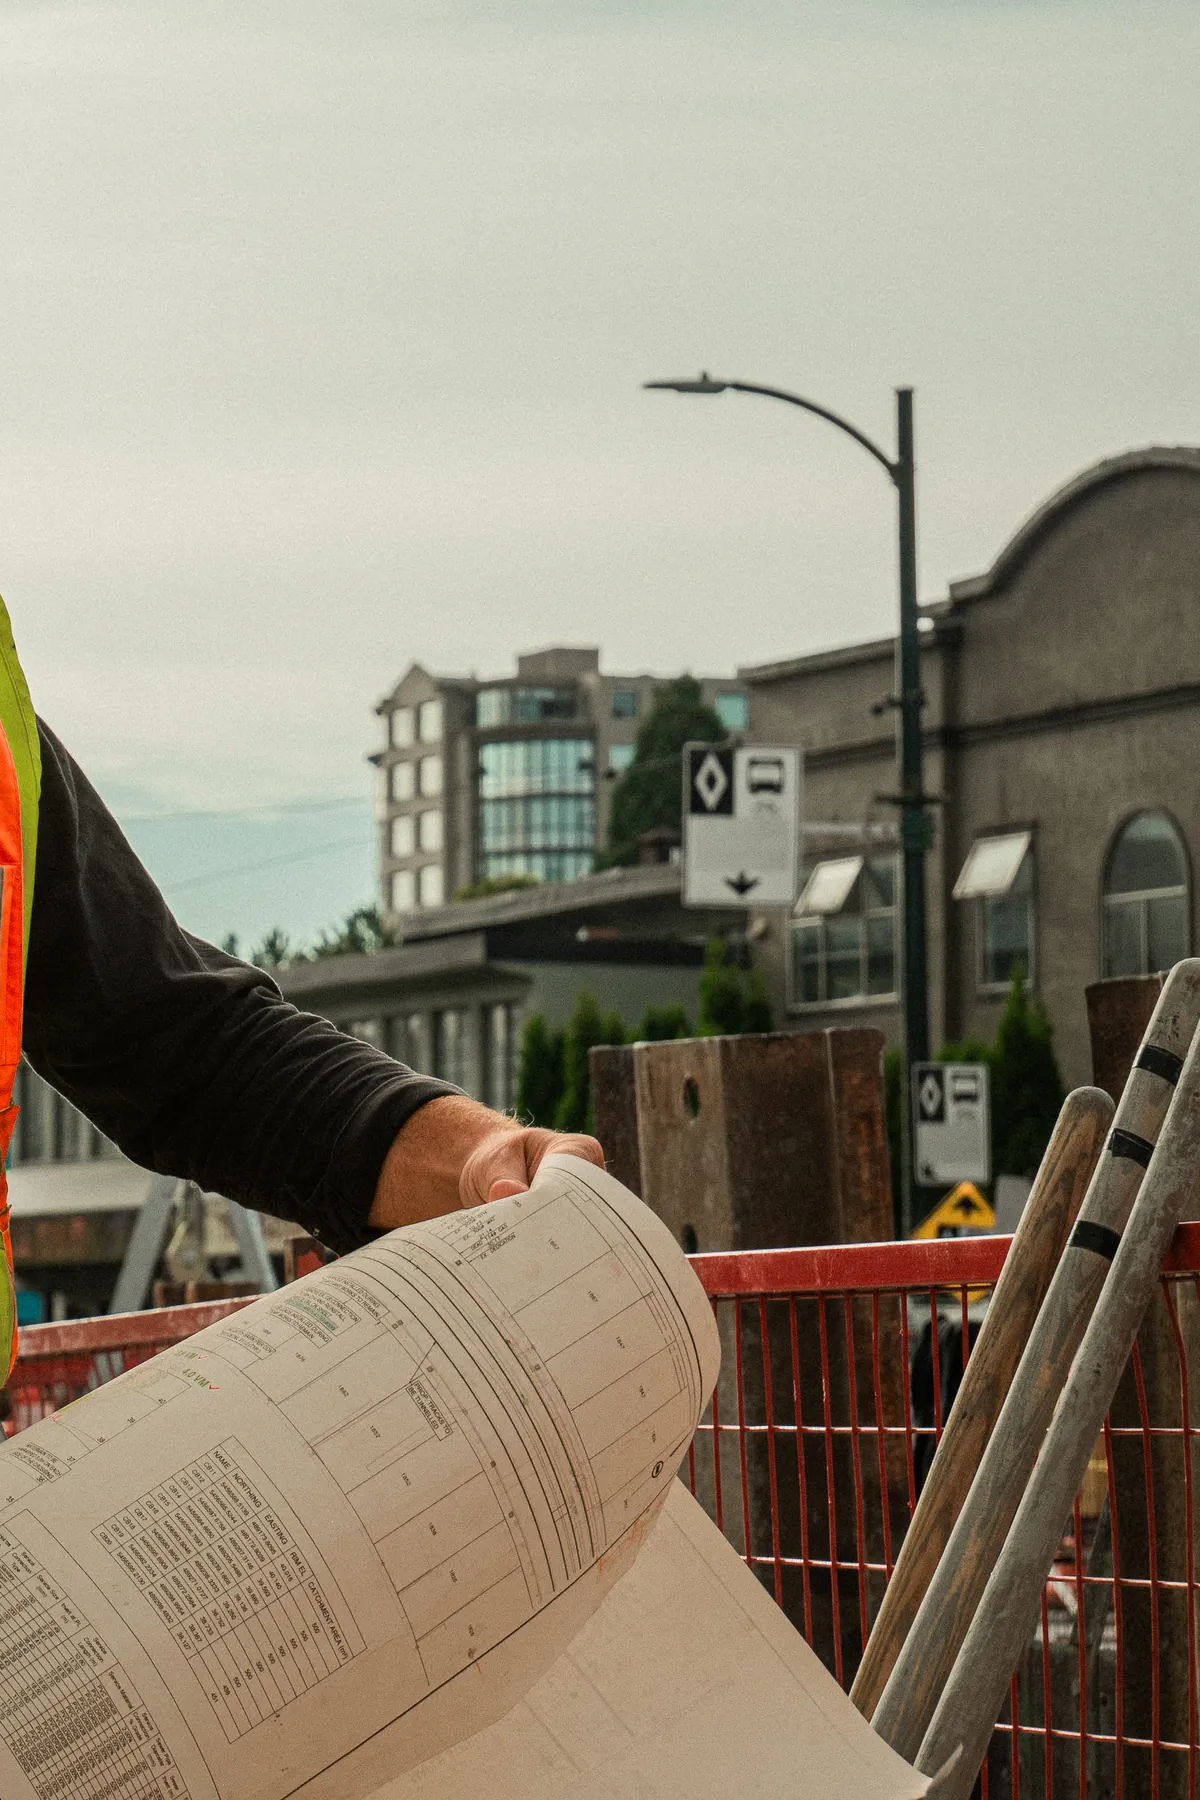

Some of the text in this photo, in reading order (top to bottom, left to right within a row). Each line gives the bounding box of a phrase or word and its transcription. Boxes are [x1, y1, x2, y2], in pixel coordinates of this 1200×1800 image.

[360, 1299, 381, 1318] REMAIN
[361, 1290, 381, 1309] DURING
[322, 1300, 347, 1322] REINSTALL
[331, 1297, 359, 1323] CONNECTION
[295, 1323, 315, 1340] REMAIN
[309, 1324, 330, 1343] DURING
[407, 1385, 440, 1430] BE TUNNELLED
[426, 1400, 445, 1425] TRACKS
[441, 1424, 451, 1434] TO
[65, 1454, 76, 1464] 37
[98, 1530, 113, 1546] CB20
[202, 1460, 321, 1634] CB11 500
[212, 1449, 232, 1470] NAME
[231, 1471, 263, 1509] NORTHING
[262, 1513, 289, 1546] EASTING
[287, 1550, 302, 1567] RIM
[296, 1564, 308, 1577] EL
[304, 1580, 334, 1626] CATCHMENT
[327, 1624, 343, 1646] AREA
[9, 1549, 36, 1575] Service Connection Type
[190, 1468, 206, 1484] CB12
[298, 1629, 310, 1642] 500
[156, 1491, 171, 1507] CB15
[265, 1652, 276, 1665] 500
[167, 1483, 182, 1500] CB14
[275, 1644, 287, 1658] 500
[35, 1573, 53, 1592] Service
[49, 1589, 61, 1601] Size
[133, 1506, 148, 1523] CB17
[242, 1667, 254, 1681] 500
[59, 1601, 73, 1617] Invert
[59, 1612, 71, 1625] (m)
[73, 1619, 83, 1628] PL
[75, 1635, 108, 1668] Service Connection Length (m)
[287, 1636, 299, 1650] 500
[253, 1660, 265, 1673] 500
[94, 1683, 106, 1697] PVC
[107, 1670, 135, 1710] Service Material
[231, 1675, 242, 1689] 500
[76, 1696, 88, 1709] PVC
[82, 1692, 94, 1705] PVC
[88, 1687, 100, 1701] PVC
[130, 1710, 151, 1740] Connection
[139, 1711, 155, 1732] Service
[129, 1723, 144, 1742] Grade
[149, 1743, 165, 1767] Diameter
[154, 1737, 166, 1754] Sewer
[162, 1752, 172, 1766] Pipe
[168, 1774, 180, 1791] Sewer
